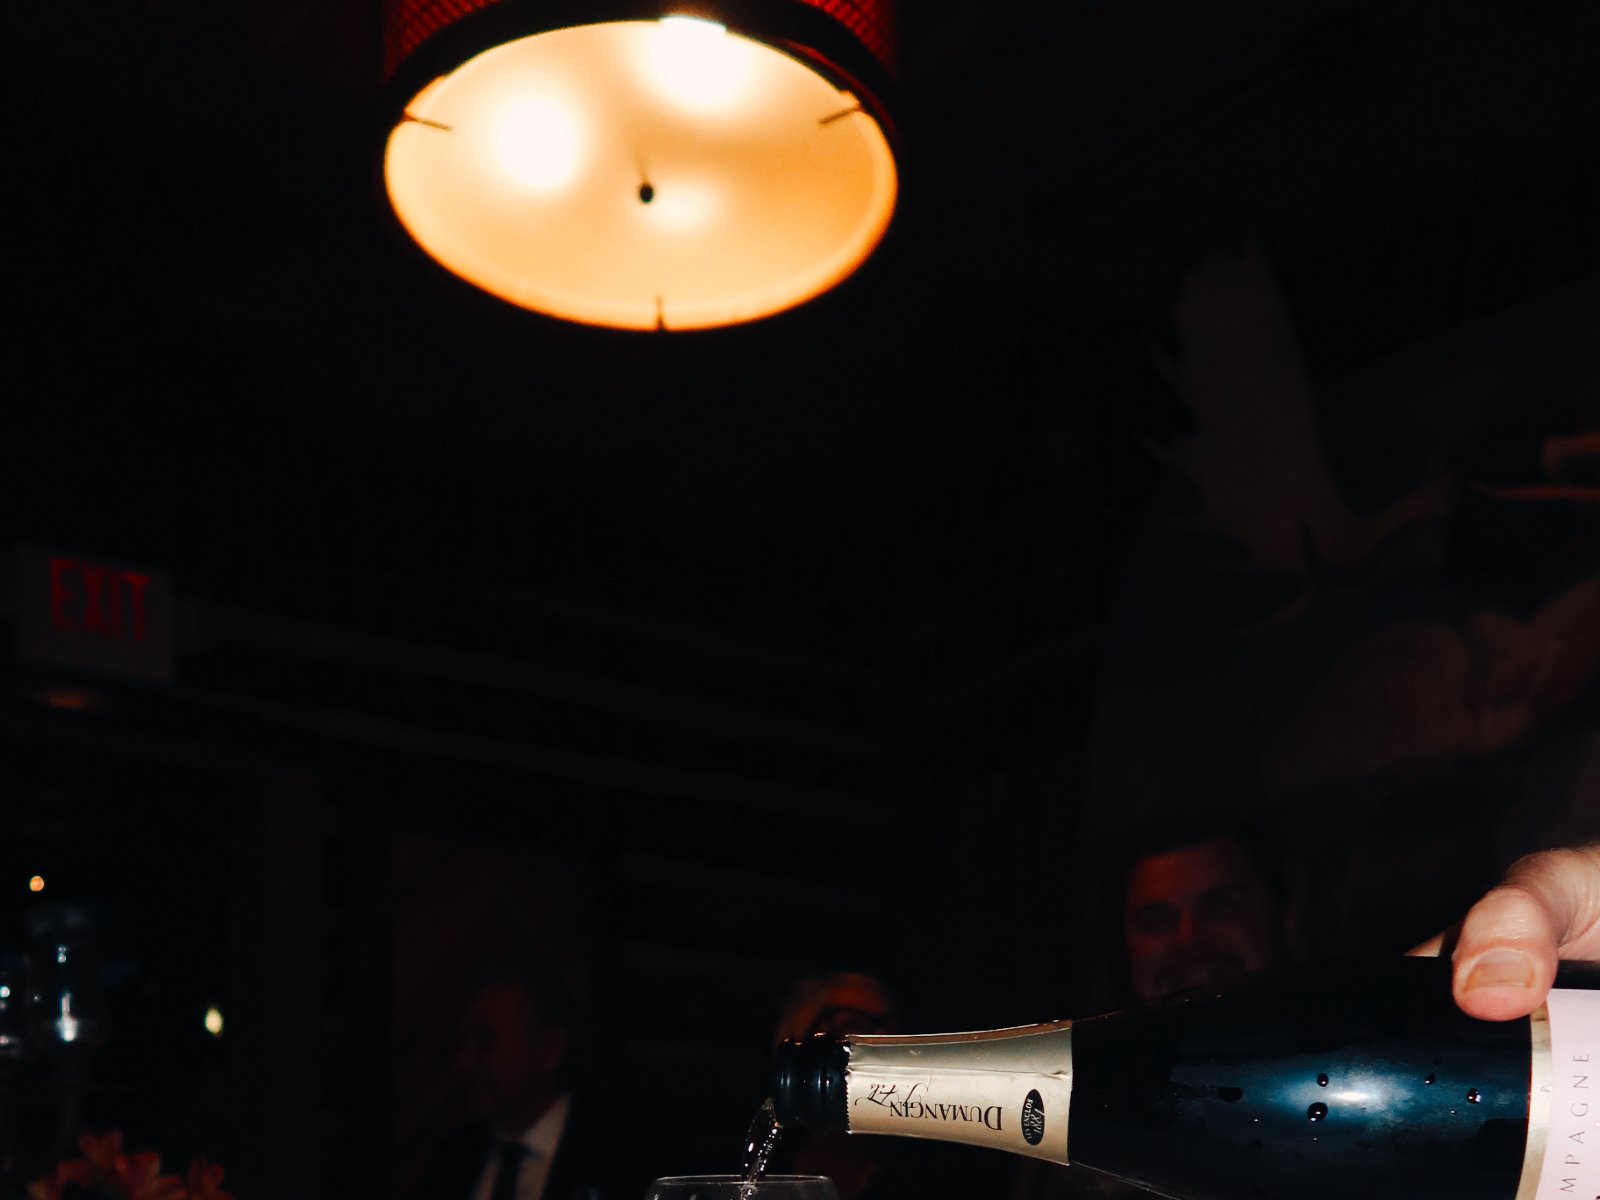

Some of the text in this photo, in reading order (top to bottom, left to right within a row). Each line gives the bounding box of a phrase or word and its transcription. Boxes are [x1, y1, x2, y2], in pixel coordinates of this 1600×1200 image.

[49, 557, 151, 643] EXIT
[855, 1084, 899, 1107] Fils
[890, 1101, 1003, 1131] DUMANGIN
[1024, 1098, 1034, 1127] ENCLOS
